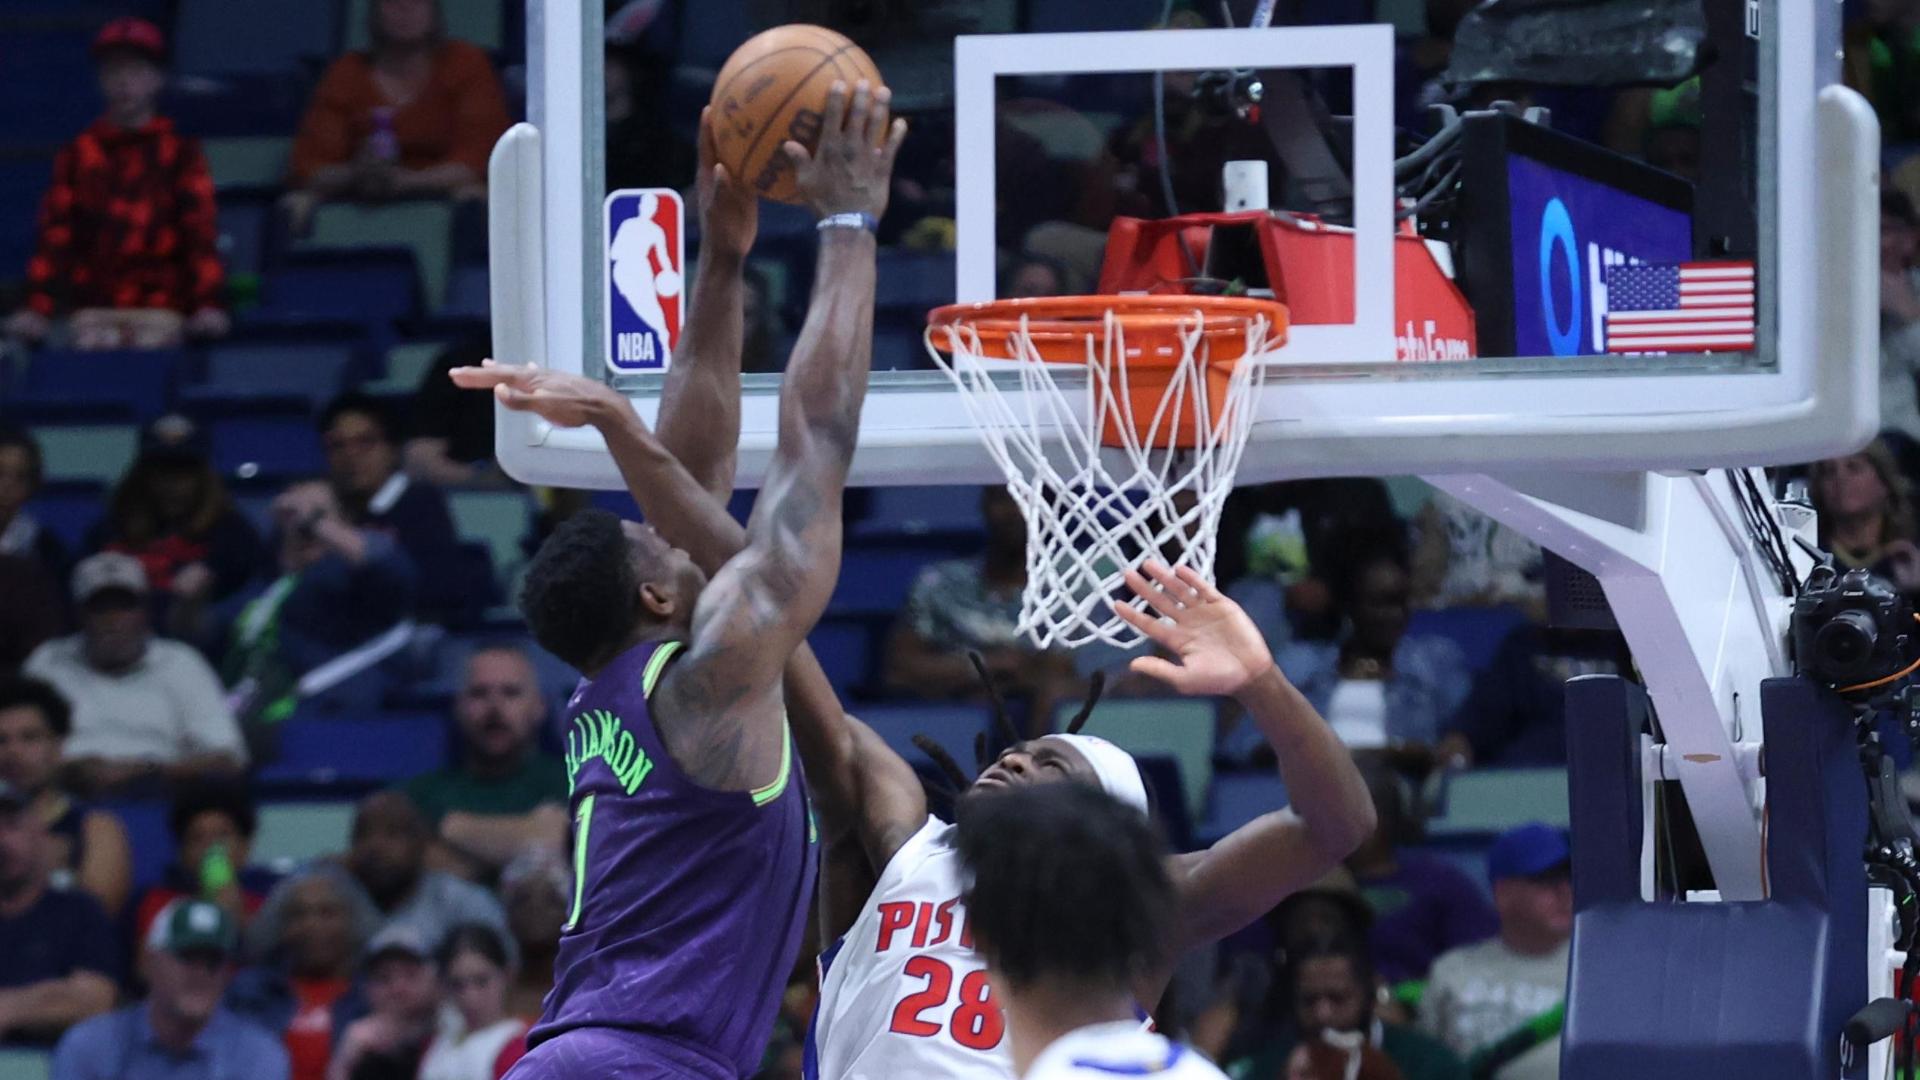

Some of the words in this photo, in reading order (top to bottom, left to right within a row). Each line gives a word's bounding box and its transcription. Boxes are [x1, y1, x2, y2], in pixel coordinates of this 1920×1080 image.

[618, 332, 655, 361] NBA
[567, 791, 595, 930] 1
[889, 955, 1005, 1050] 28
